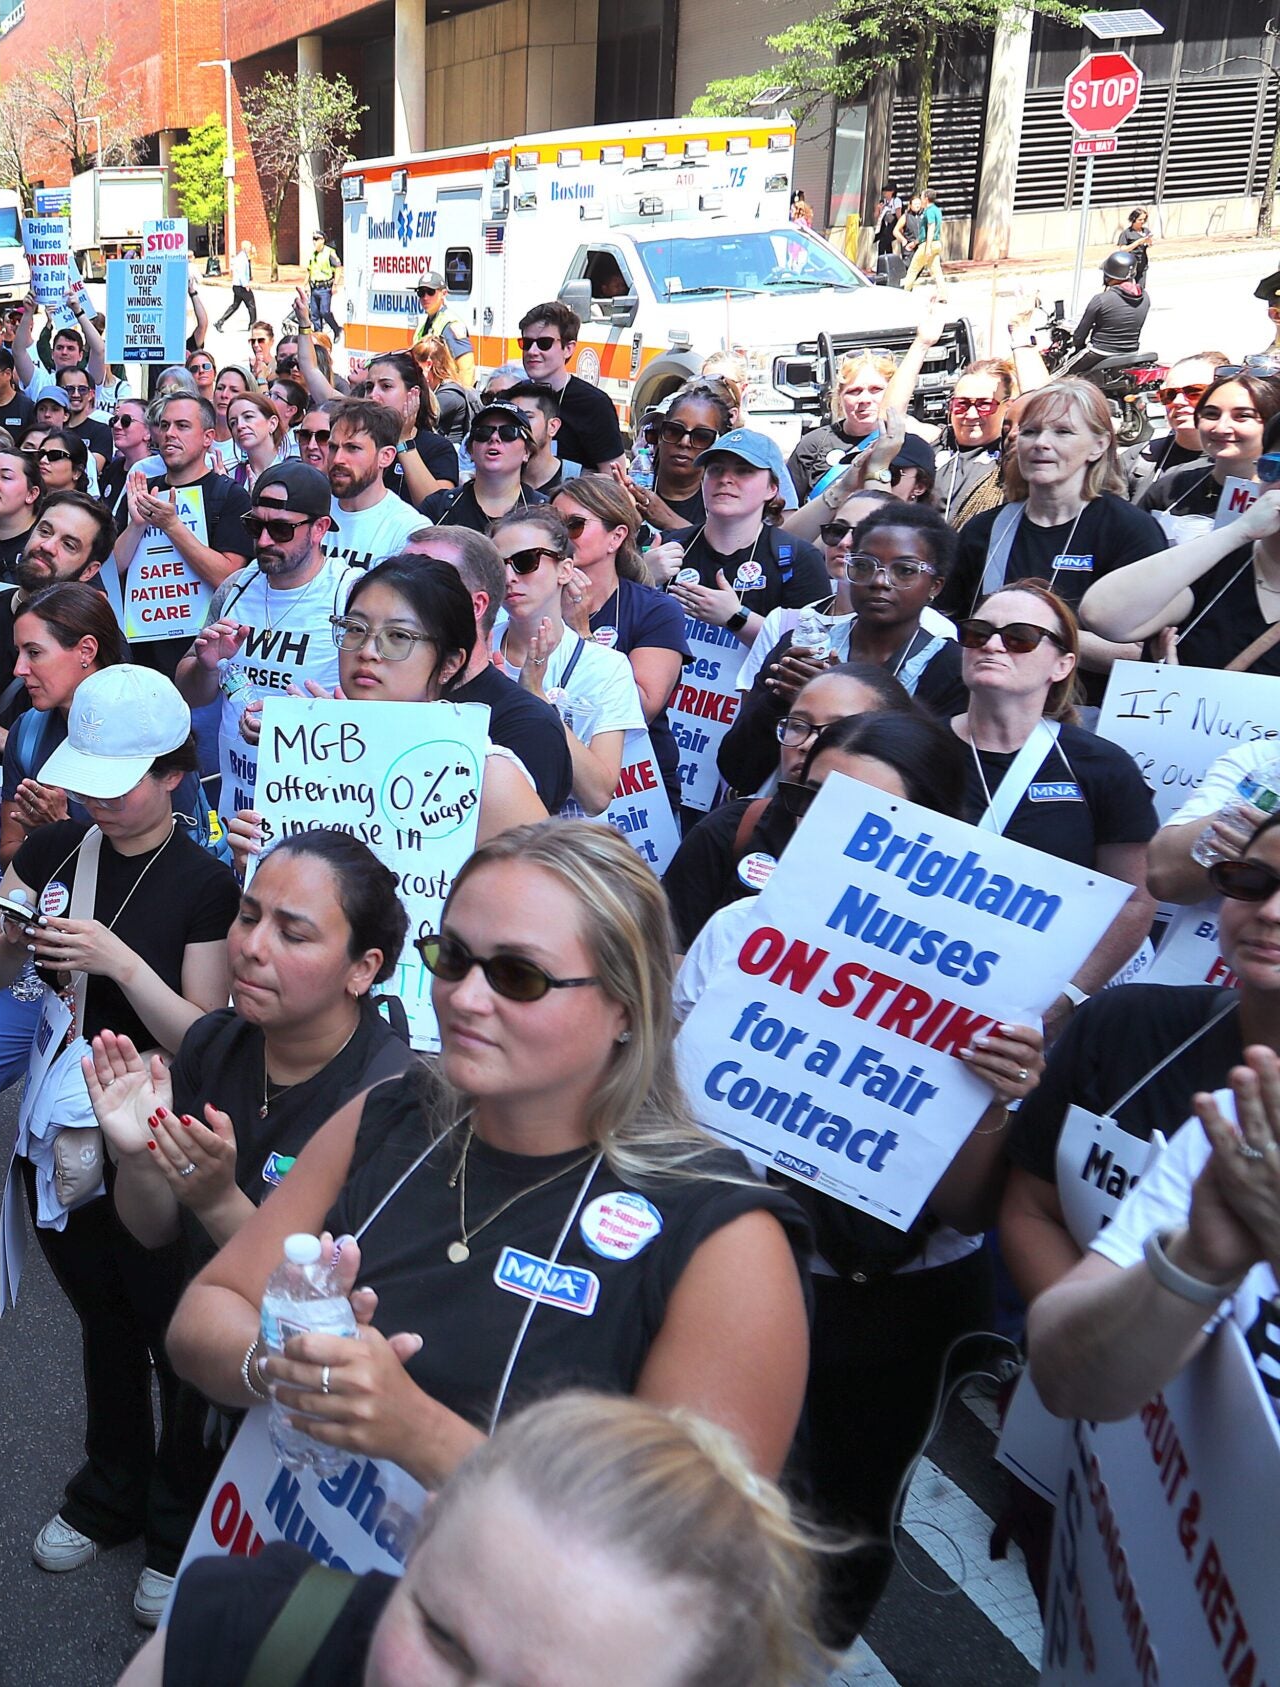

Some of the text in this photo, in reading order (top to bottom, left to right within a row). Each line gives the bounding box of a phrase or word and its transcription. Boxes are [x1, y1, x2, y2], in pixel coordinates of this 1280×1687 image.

[1070, 78, 1136, 110] STOP
[1076, 141, 1113, 153] ALL WAY
[676, 174, 695, 186] A10
[551, 181, 595, 201] Boston
[28, 223, 63, 235] Brigham
[155, 220, 175, 231] MGB
[368, 211, 437, 240] Boston EMS
[33, 239, 61, 249] Nurses
[147, 233, 184, 252] STOP
[129, 264, 162, 274] YOU CAN
[373, 256, 432, 274] EMERGENCY
[44, 273, 49, 281] a
[51, 271, 65, 281] Fair
[133, 276, 157, 285] COVER
[138, 286, 152, 296] THE
[127, 297, 163, 306] WINDOWS.
[373, 294, 424, 314] AMBULANC
[126, 314, 162, 323] YOU CAN'T
[133, 325, 155, 334] COVER
[125, 335, 163, 345] THE TRUTH.
[140, 562, 185, 579] SAFE
[1056, 558, 1090, 567] MNA
[131, 581, 201, 602] PATIENT
[141, 604, 191, 622] CARE
[668, 684, 740, 725] TRIKE
[1117, 689, 1180, 725] If
[274, 723, 366, 765] MGB
[672, 722, 710, 754] Fair
[229, 749, 257, 786] Brig
[266, 775, 376, 817] offering
[390, 766, 450, 811] 0%
[455, 762, 471, 777] in
[1033, 786, 1078, 797] MNA
[420, 787, 479, 827] wages
[397, 817, 422, 851] in
[842, 811, 1062, 934] Brigham
[825, 884, 1001, 987] Nurses
[737, 926, 1008, 1059] ON STRIK
[730, 1001, 940, 1117] for a Fair
[704, 1060, 899, 1173] Contract
[777, 1151, 817, 1177] MNA
[599, 1203, 653, 1230] We Support
[600, 1218, 641, 1241] Brigham
[595, 1231, 634, 1252] Nurses!
[504, 1257, 582, 1298] MNA
